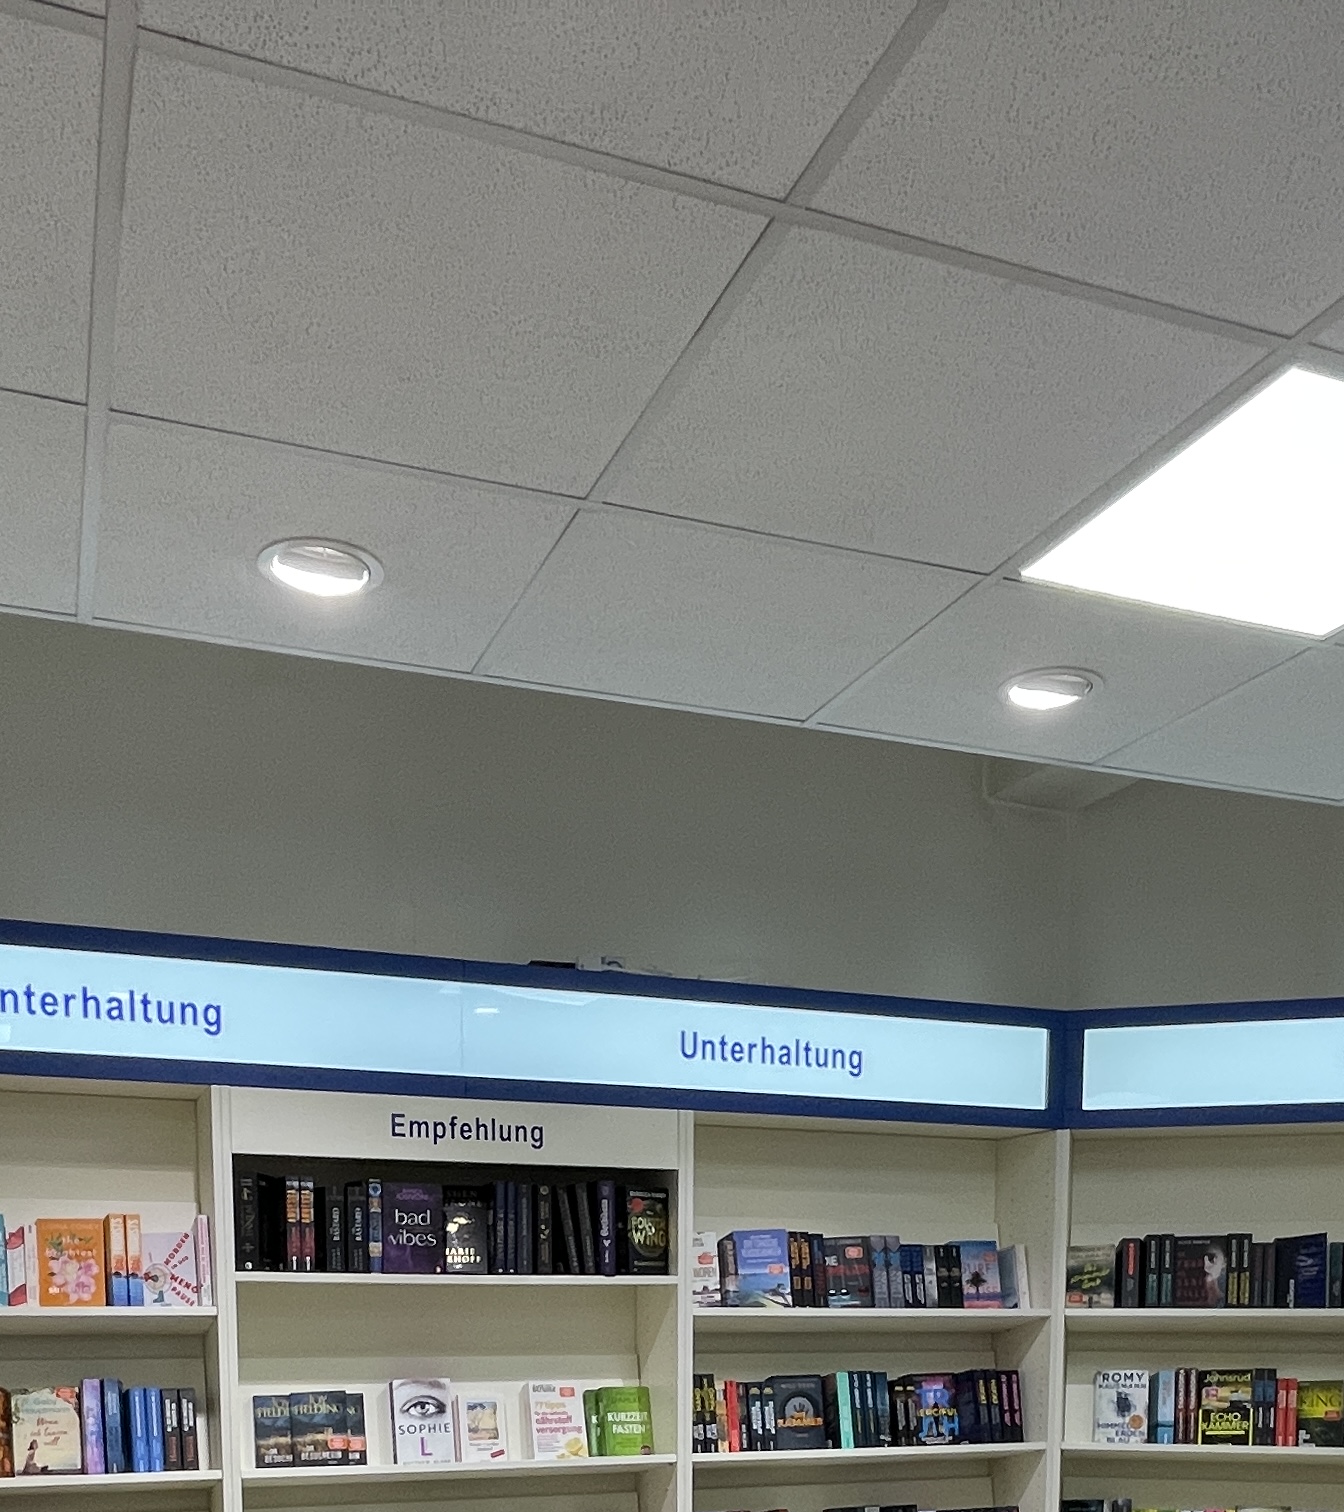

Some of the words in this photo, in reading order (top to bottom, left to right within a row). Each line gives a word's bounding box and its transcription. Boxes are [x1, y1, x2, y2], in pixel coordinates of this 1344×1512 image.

[680, 1031, 863, 1077] Unterhaltung
[391, 1113, 545, 1149] Empfehlung
[395, 1207, 431, 1227] bad
[389, 1229, 437, 1249] vibes
[1102, 1371, 1145, 1383] ROMY
[1210, 1412, 1241, 1422] ECHO
[398, 1422, 451, 1437] SOPHIE
[612, 1423, 646, 1436] FASTEN
[1201, 1421, 1251, 1431] KAMMER
